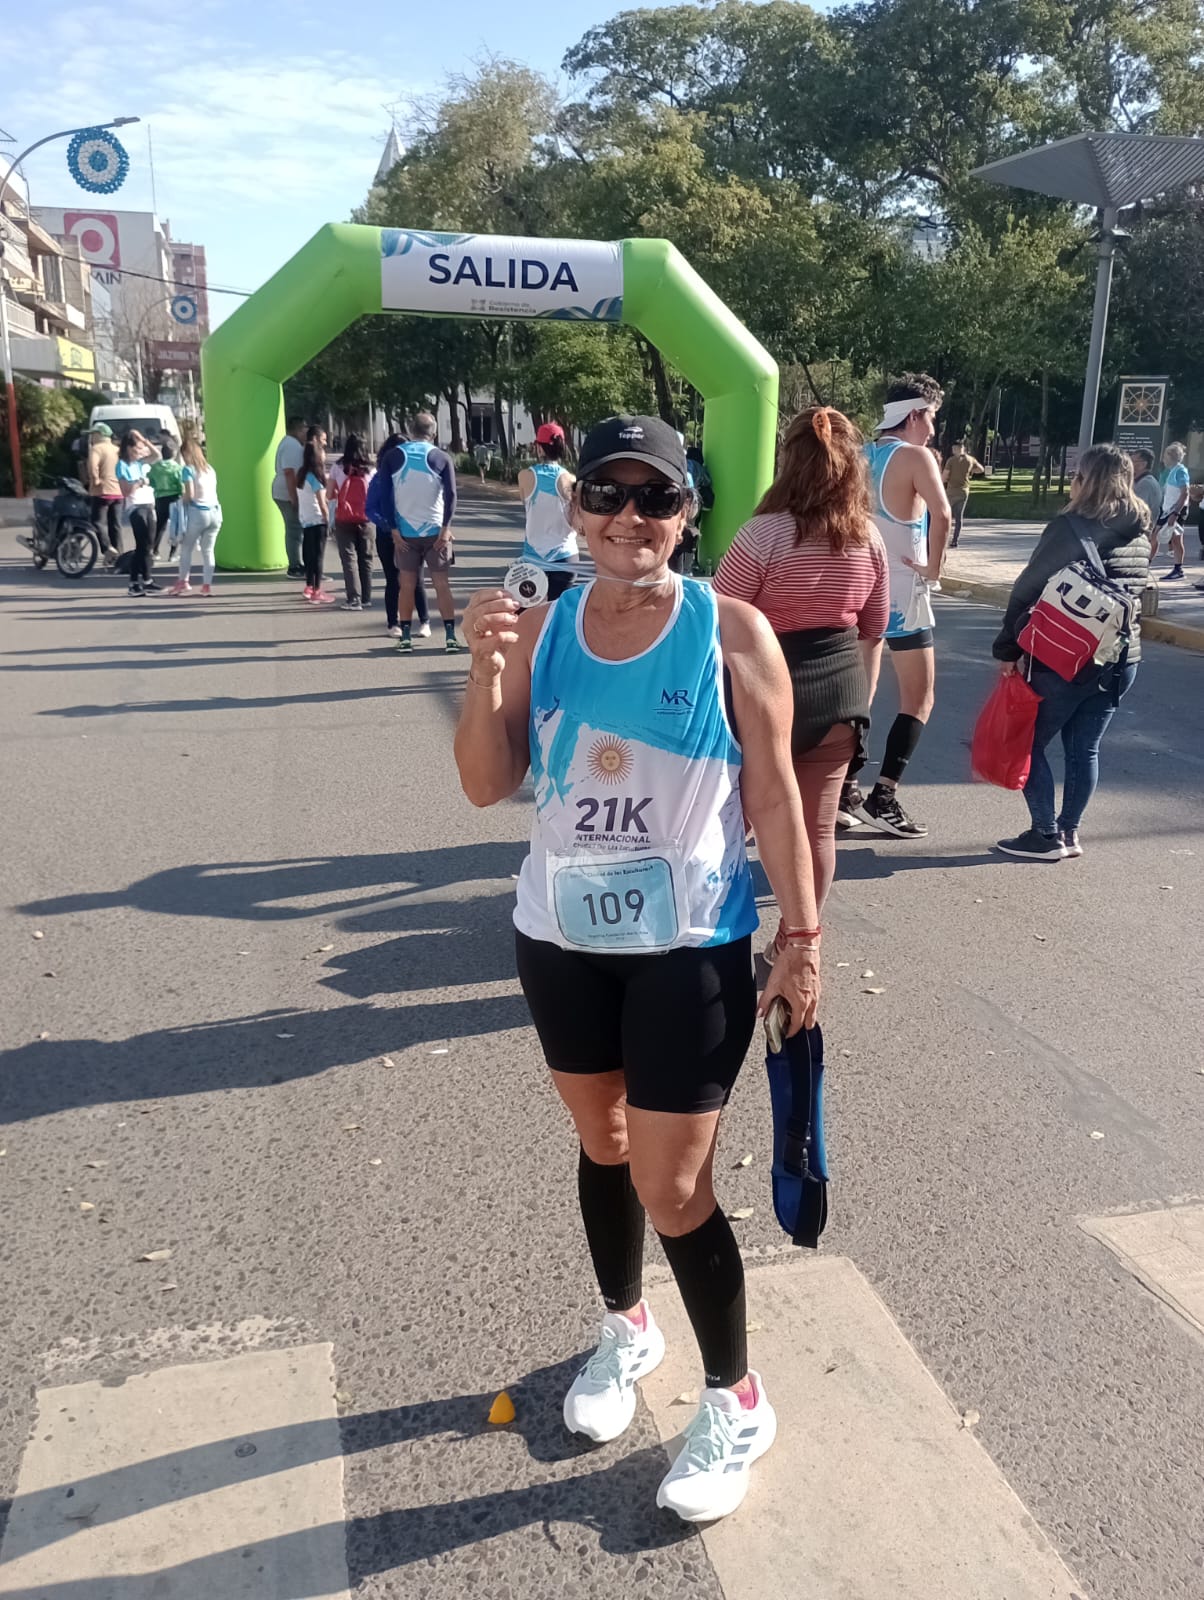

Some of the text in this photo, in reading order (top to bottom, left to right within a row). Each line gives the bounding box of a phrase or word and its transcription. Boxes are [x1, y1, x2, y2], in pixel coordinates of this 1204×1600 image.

[428, 253, 579, 292] SALIDA
[488, 305, 537, 314] Resistencia
[660, 687, 694, 707] MR
[575, 797, 654, 833] 21K
[574, 833, 652, 844] NTERNACIONAL
[582, 889, 645, 926] 109
